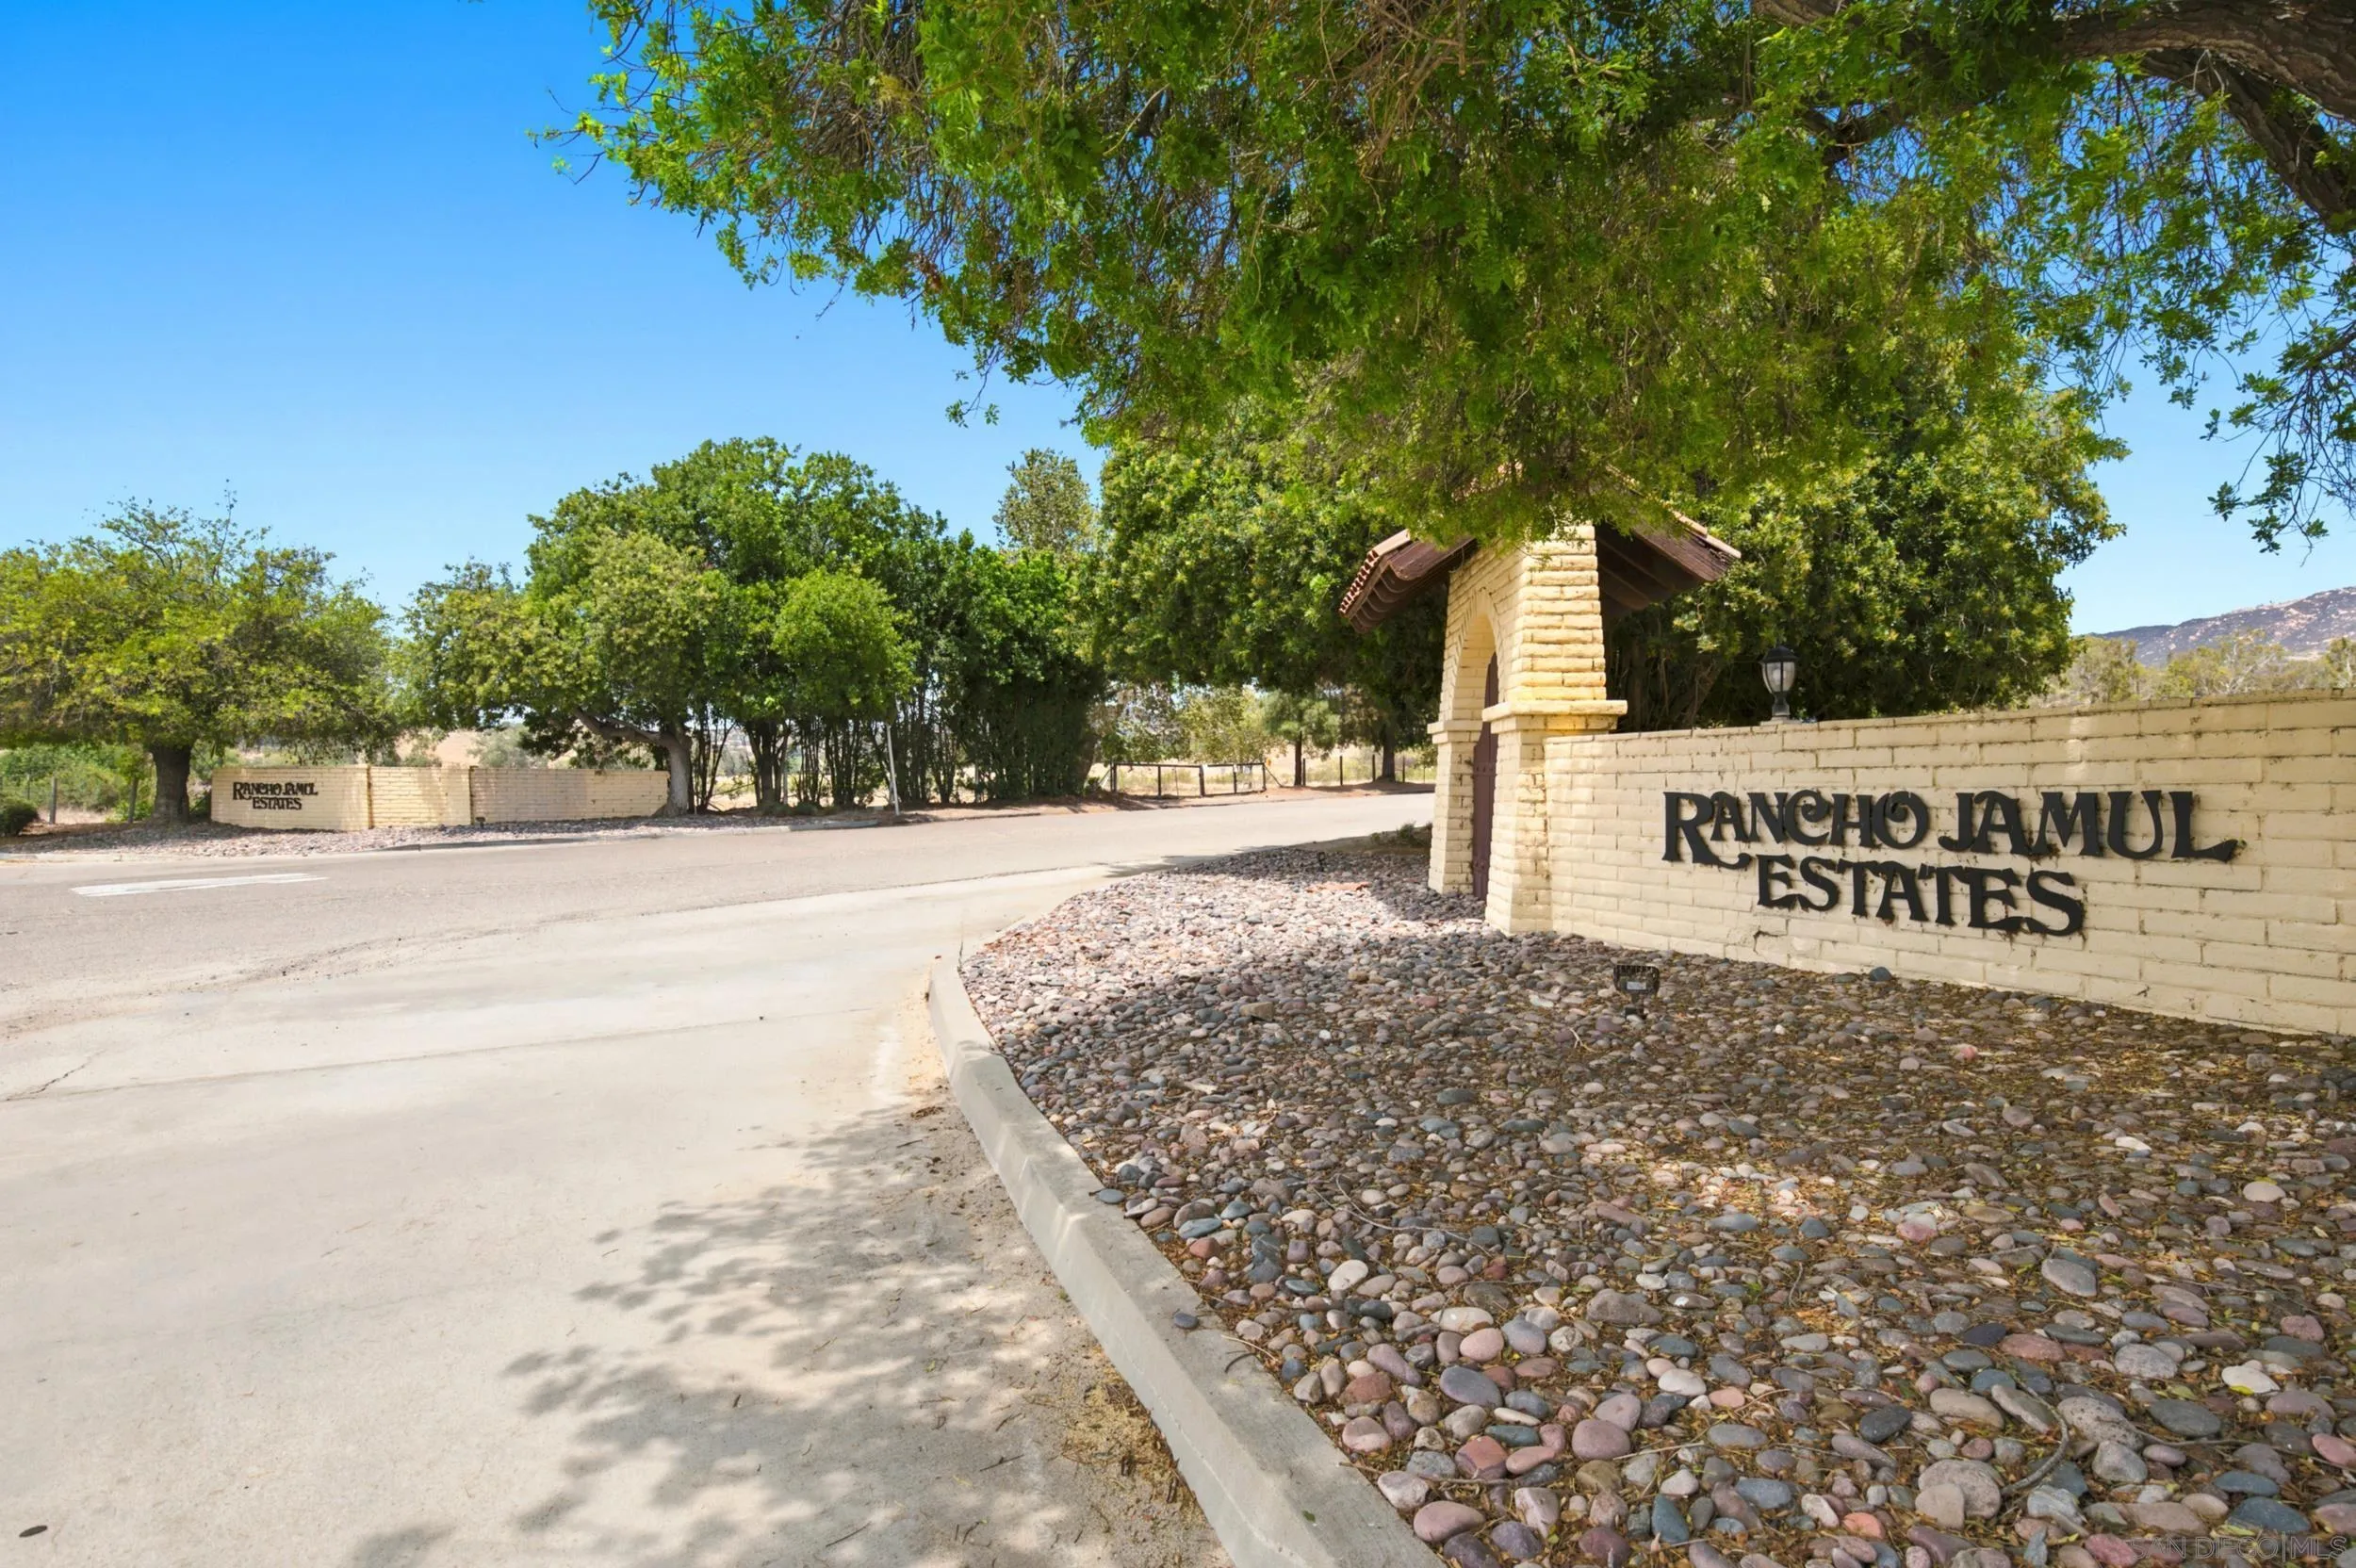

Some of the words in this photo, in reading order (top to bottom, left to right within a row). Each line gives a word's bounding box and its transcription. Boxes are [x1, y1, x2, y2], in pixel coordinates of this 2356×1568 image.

[232, 781, 282, 800] RANCHO
[252, 796, 303, 810] ESTATES
[1661, 790, 1929, 870] RANCHO
[1938, 790, 2247, 863] JAMUL
[1756, 854, 2086, 937] ESTATES
